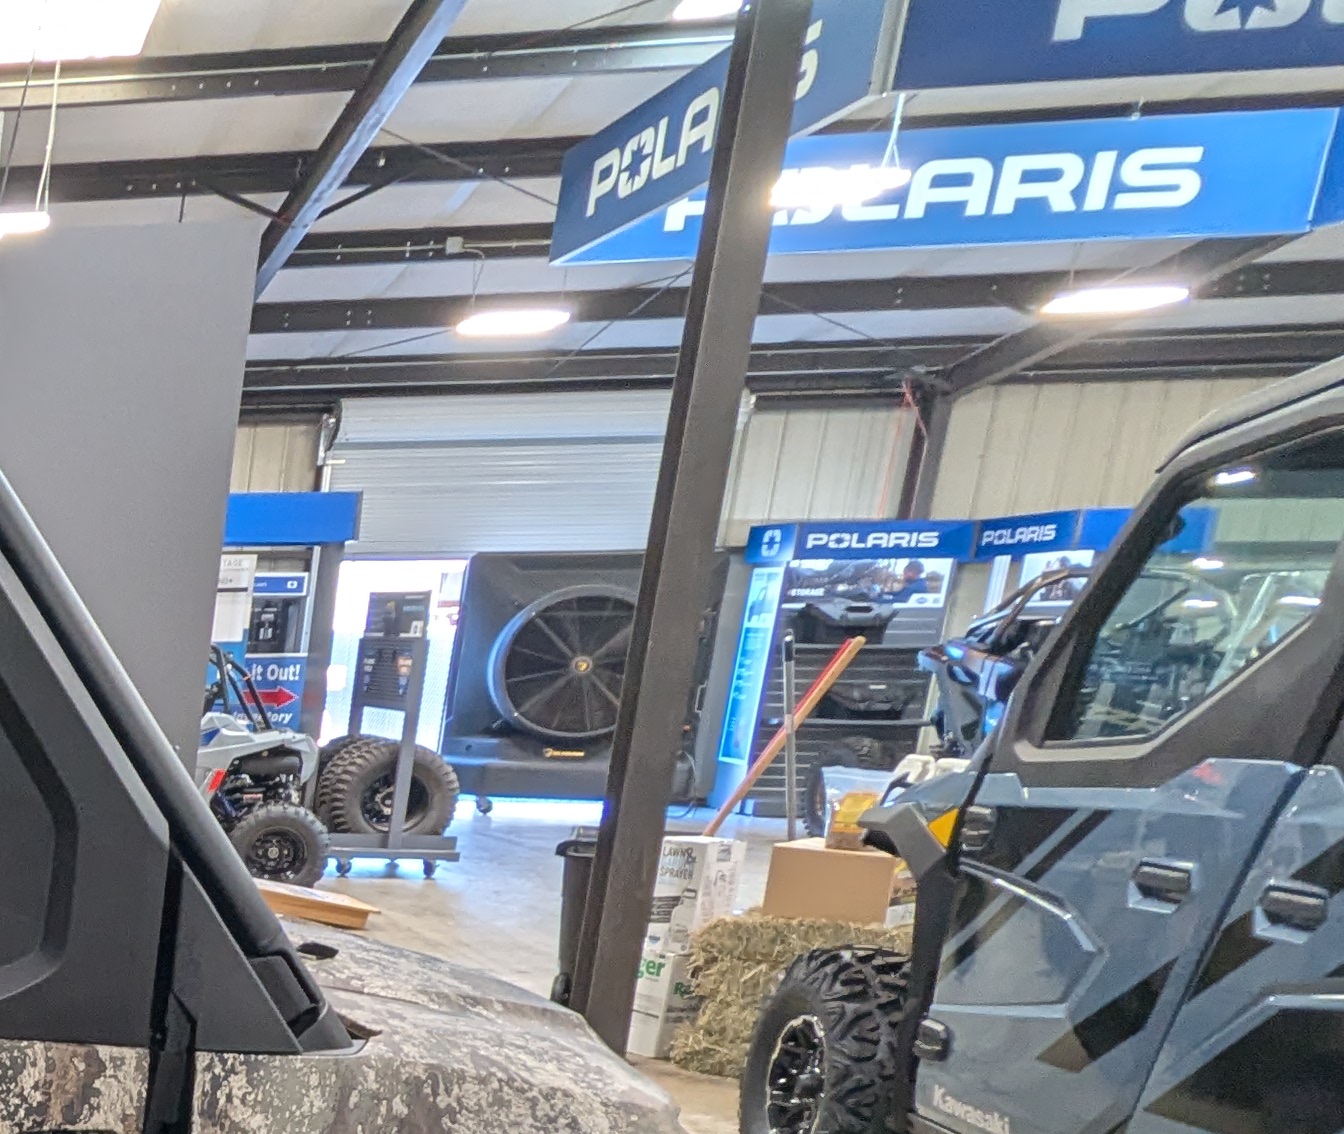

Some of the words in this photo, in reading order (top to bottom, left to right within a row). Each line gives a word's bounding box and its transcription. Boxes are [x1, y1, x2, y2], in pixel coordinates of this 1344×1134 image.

[585, 18, 823, 218] POLAS
[806, 532, 940, 549] POLARIS
[981, 524, 1057, 546] POLARIS
[266, 663, 301, 681] Out!
